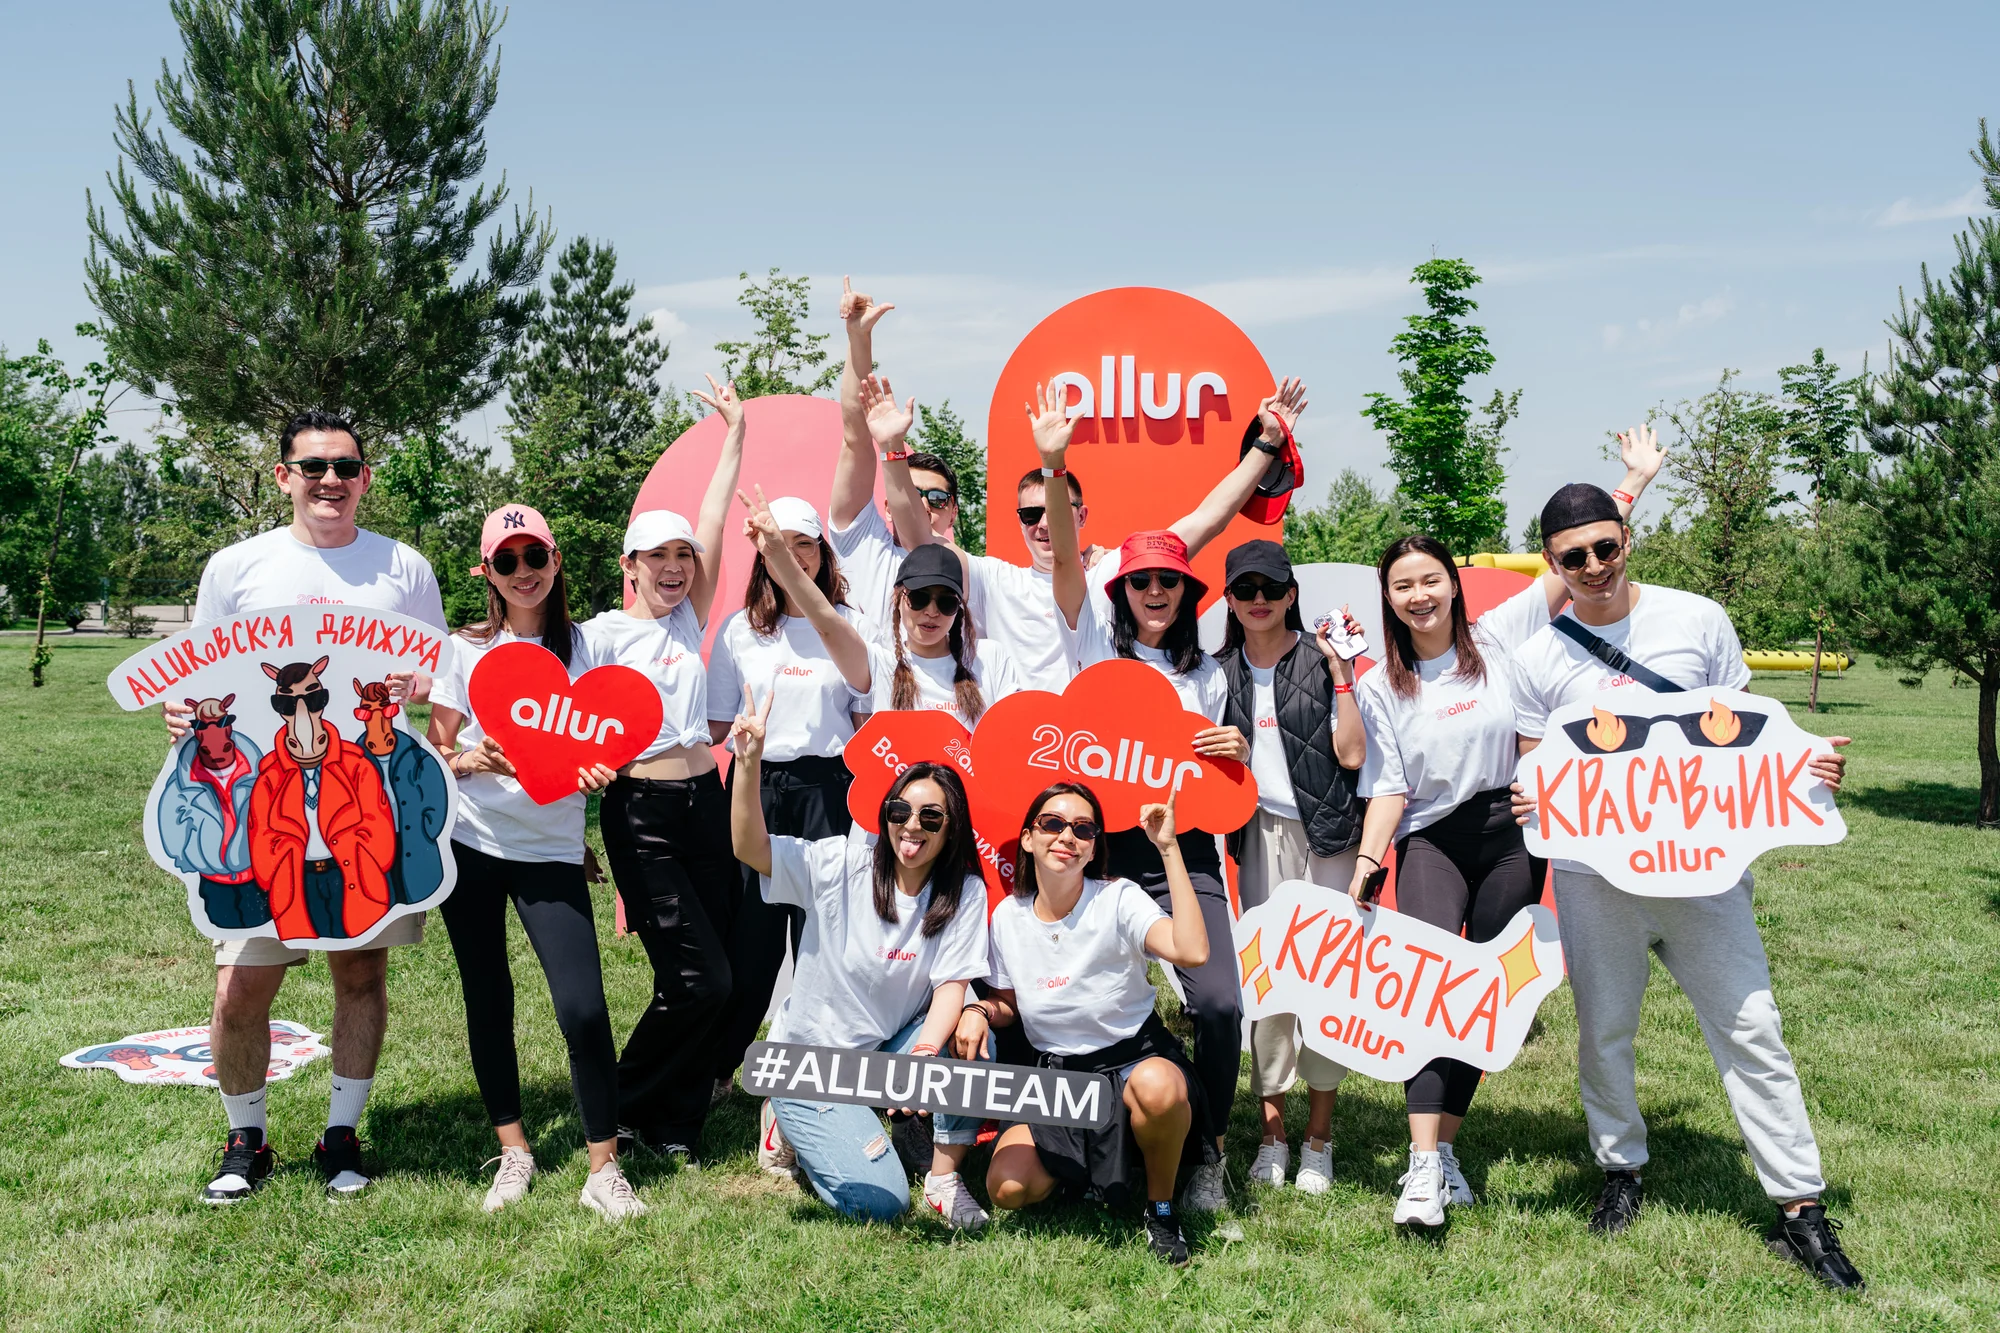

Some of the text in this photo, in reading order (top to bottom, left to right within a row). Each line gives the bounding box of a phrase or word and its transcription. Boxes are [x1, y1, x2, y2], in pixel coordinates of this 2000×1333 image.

[1046, 356, 1227, 420] allur
[503, 511, 525, 529] NY
[316, 614, 443, 673] ДВИЖУХА
[510, 693, 625, 745] allur
[1629, 840, 1726, 874] allur
[1275, 903, 1500, 1053] КРАСОТКА
[1320, 1015, 1405, 1060] allur
[751, 1047, 1101, 1122] #ALLURTEAM
